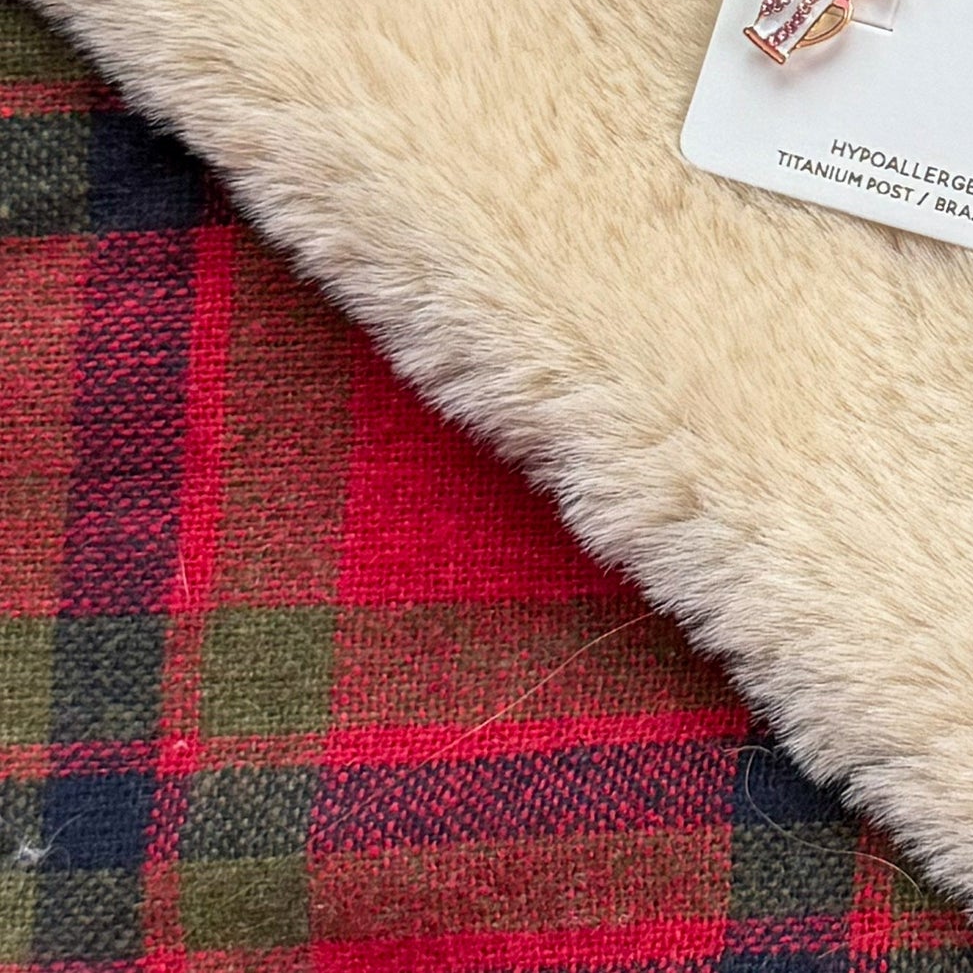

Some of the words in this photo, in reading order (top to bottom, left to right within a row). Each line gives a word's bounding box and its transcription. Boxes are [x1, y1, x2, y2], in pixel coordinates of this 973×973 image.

[777, 149, 864, 188] TITANIUM
[866, 176, 915, 203] POST
[917, 191, 929, 206] /
